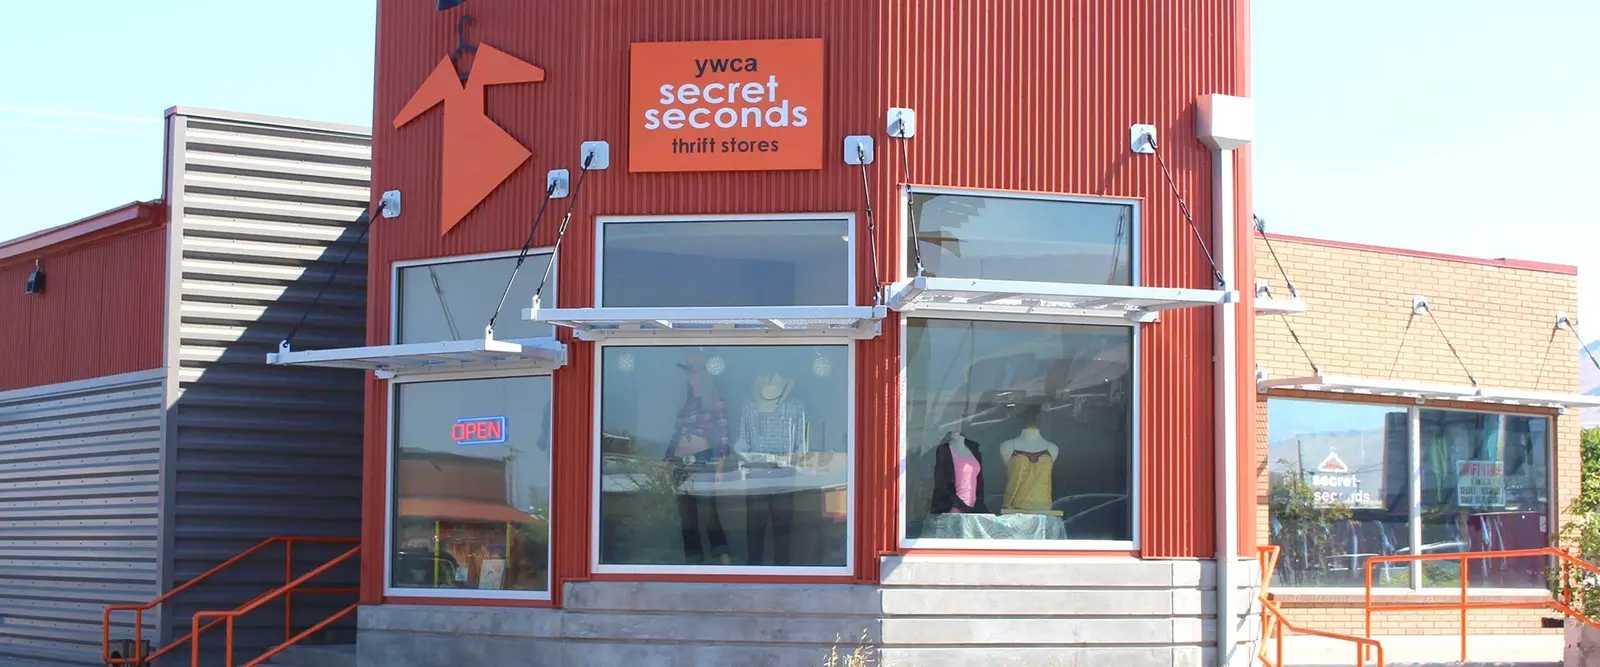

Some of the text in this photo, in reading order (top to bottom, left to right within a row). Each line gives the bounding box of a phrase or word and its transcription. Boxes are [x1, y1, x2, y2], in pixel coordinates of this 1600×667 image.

[695, 57, 757, 78] ywca
[659, 75, 778, 104] secret
[644, 100, 808, 130] seconds
[672, 137, 779, 154] thrift stores
[452, 420, 501, 441] OPEN
[1313, 490, 1370, 502] secds
